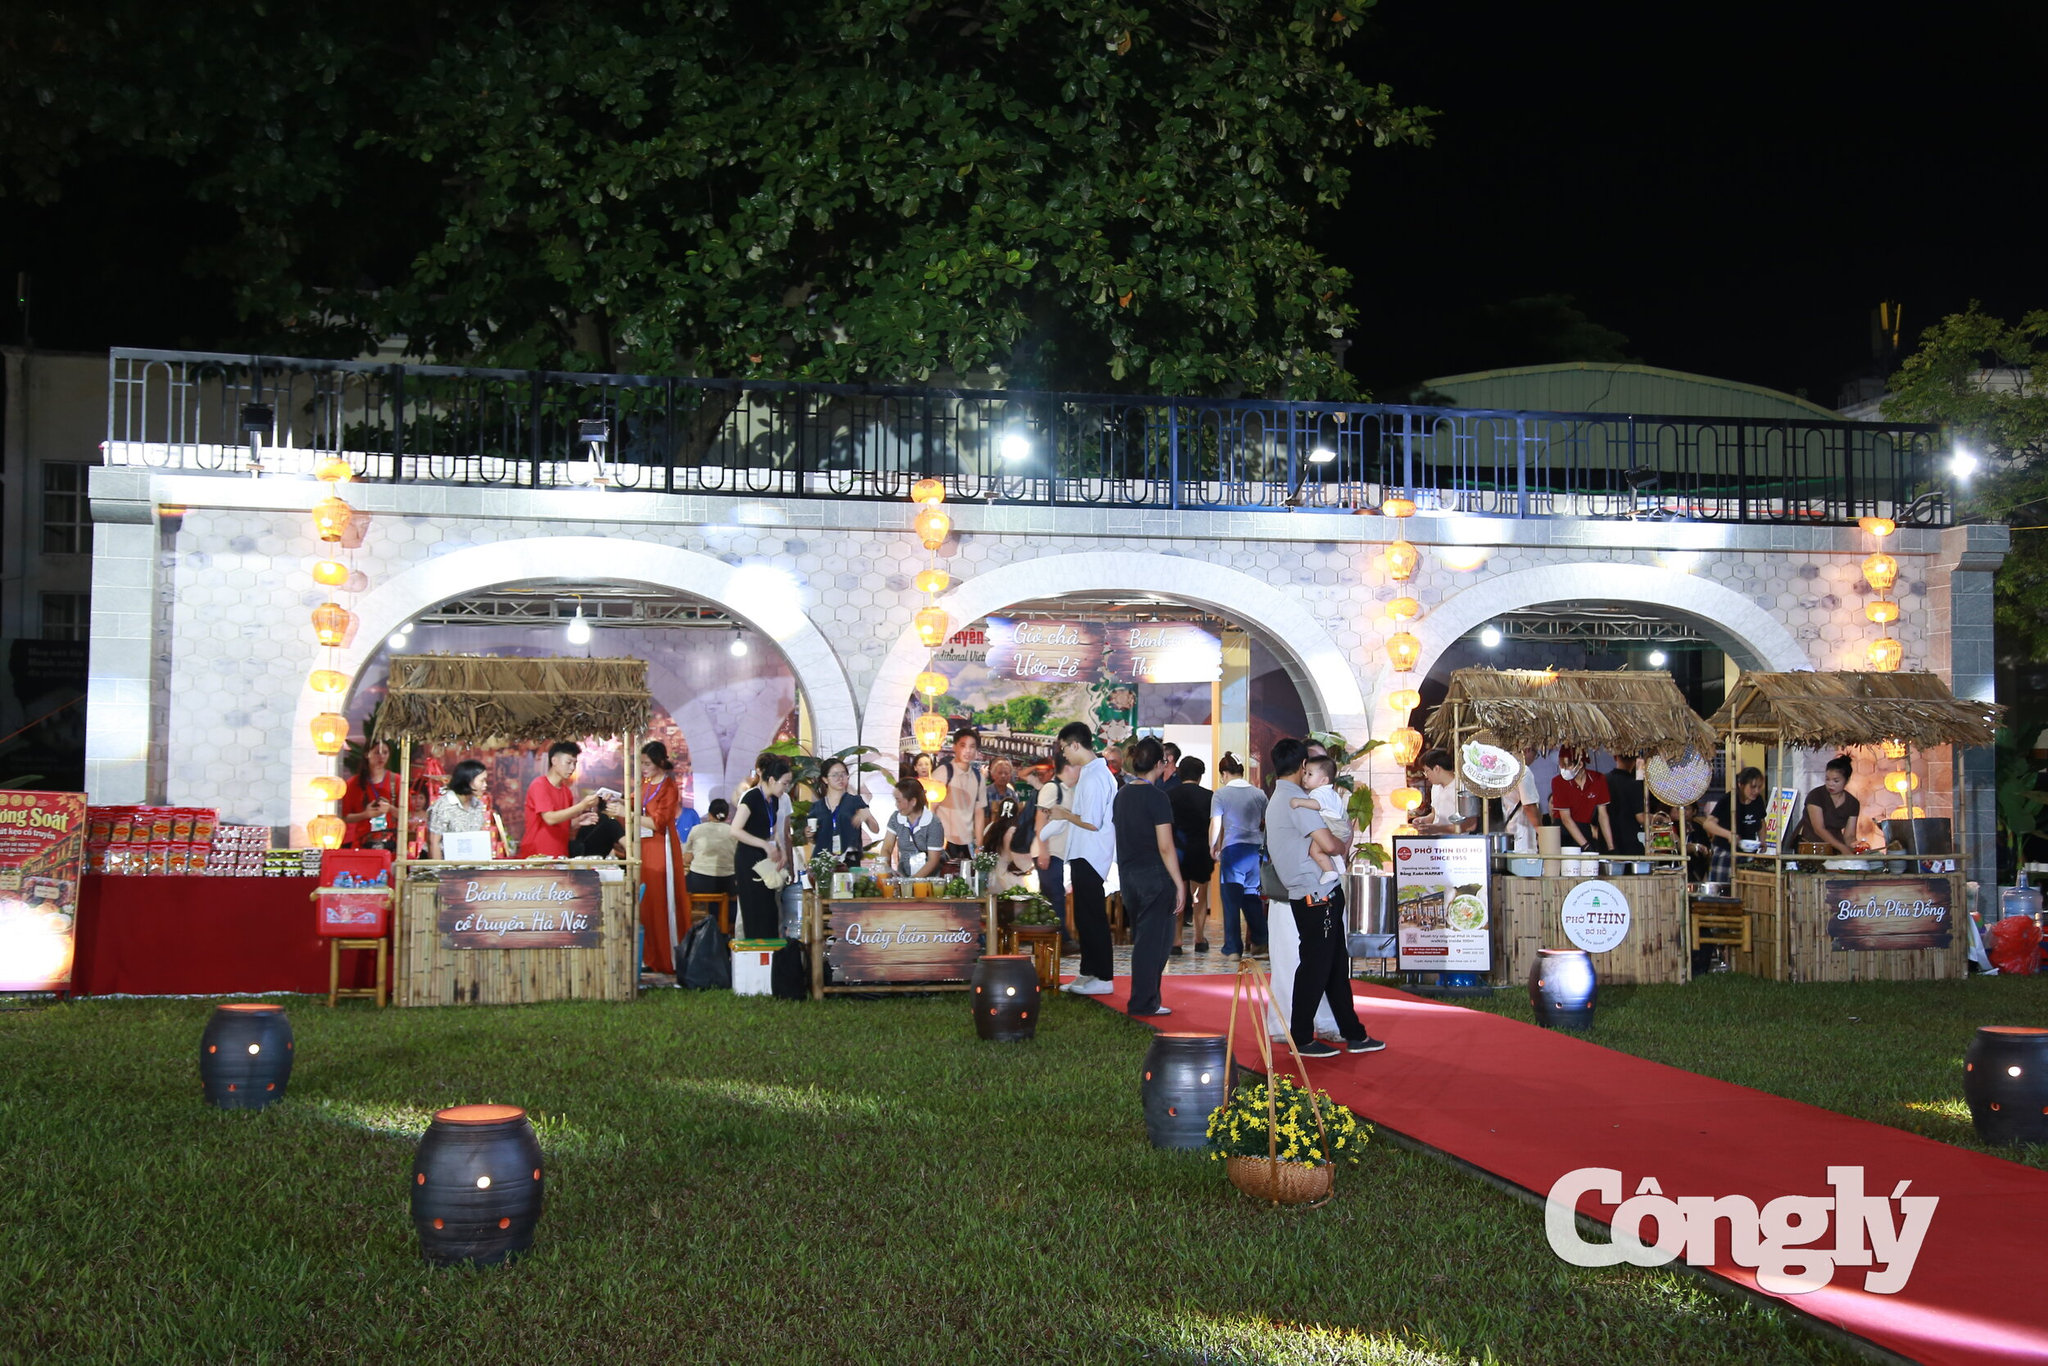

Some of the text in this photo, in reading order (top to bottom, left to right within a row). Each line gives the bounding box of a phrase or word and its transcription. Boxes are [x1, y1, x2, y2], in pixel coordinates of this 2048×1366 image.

[1014, 622, 1080, 645] Giò chả
[1129, 628, 1168, 649] Bánh
[1014, 652, 1081, 678] Ước Lễ
[1414, 845, 1432, 854] PHỞ
[465, 881, 508, 903] Bánh
[548, 882, 575, 905] kẹo
[1586, 910, 1626, 924] THÌN
[1837, 899, 1865, 920] Bún
[1885, 899, 1910, 918] Phù
[532, 910, 555, 931] Hà
[560, 911, 588, 933] Nội
[896, 924, 929, 944] bán
[932, 927, 972, 944] nước
